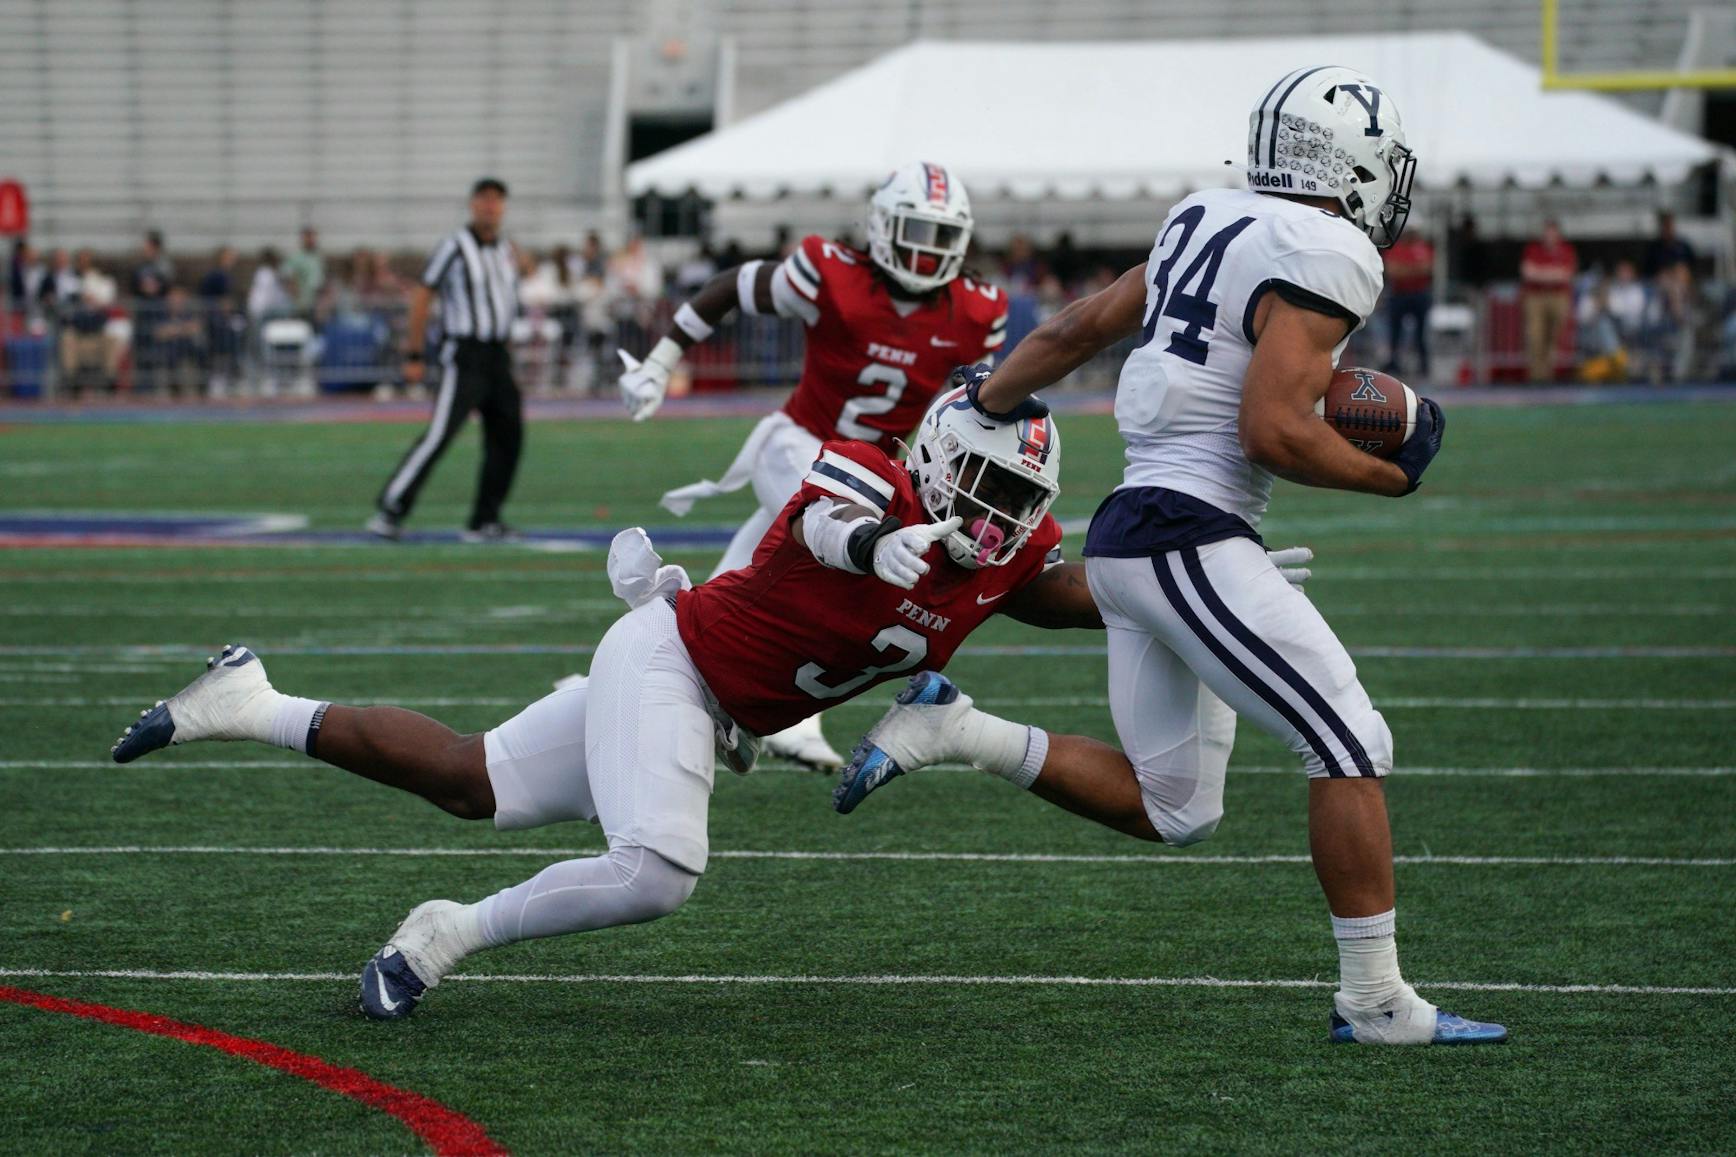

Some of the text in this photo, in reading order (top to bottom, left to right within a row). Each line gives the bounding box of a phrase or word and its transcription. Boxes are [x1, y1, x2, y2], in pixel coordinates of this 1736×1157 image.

[1338, 84, 1383, 137] Y
[1300, 180, 1317, 191] 149
[1142, 205, 1256, 366] 34
[866, 342, 918, 366] PENN
[836, 362, 908, 442] 2
[1020, 458, 1042, 473] PENN
[896, 598, 951, 633] PENN
[795, 625, 928, 700] 3
